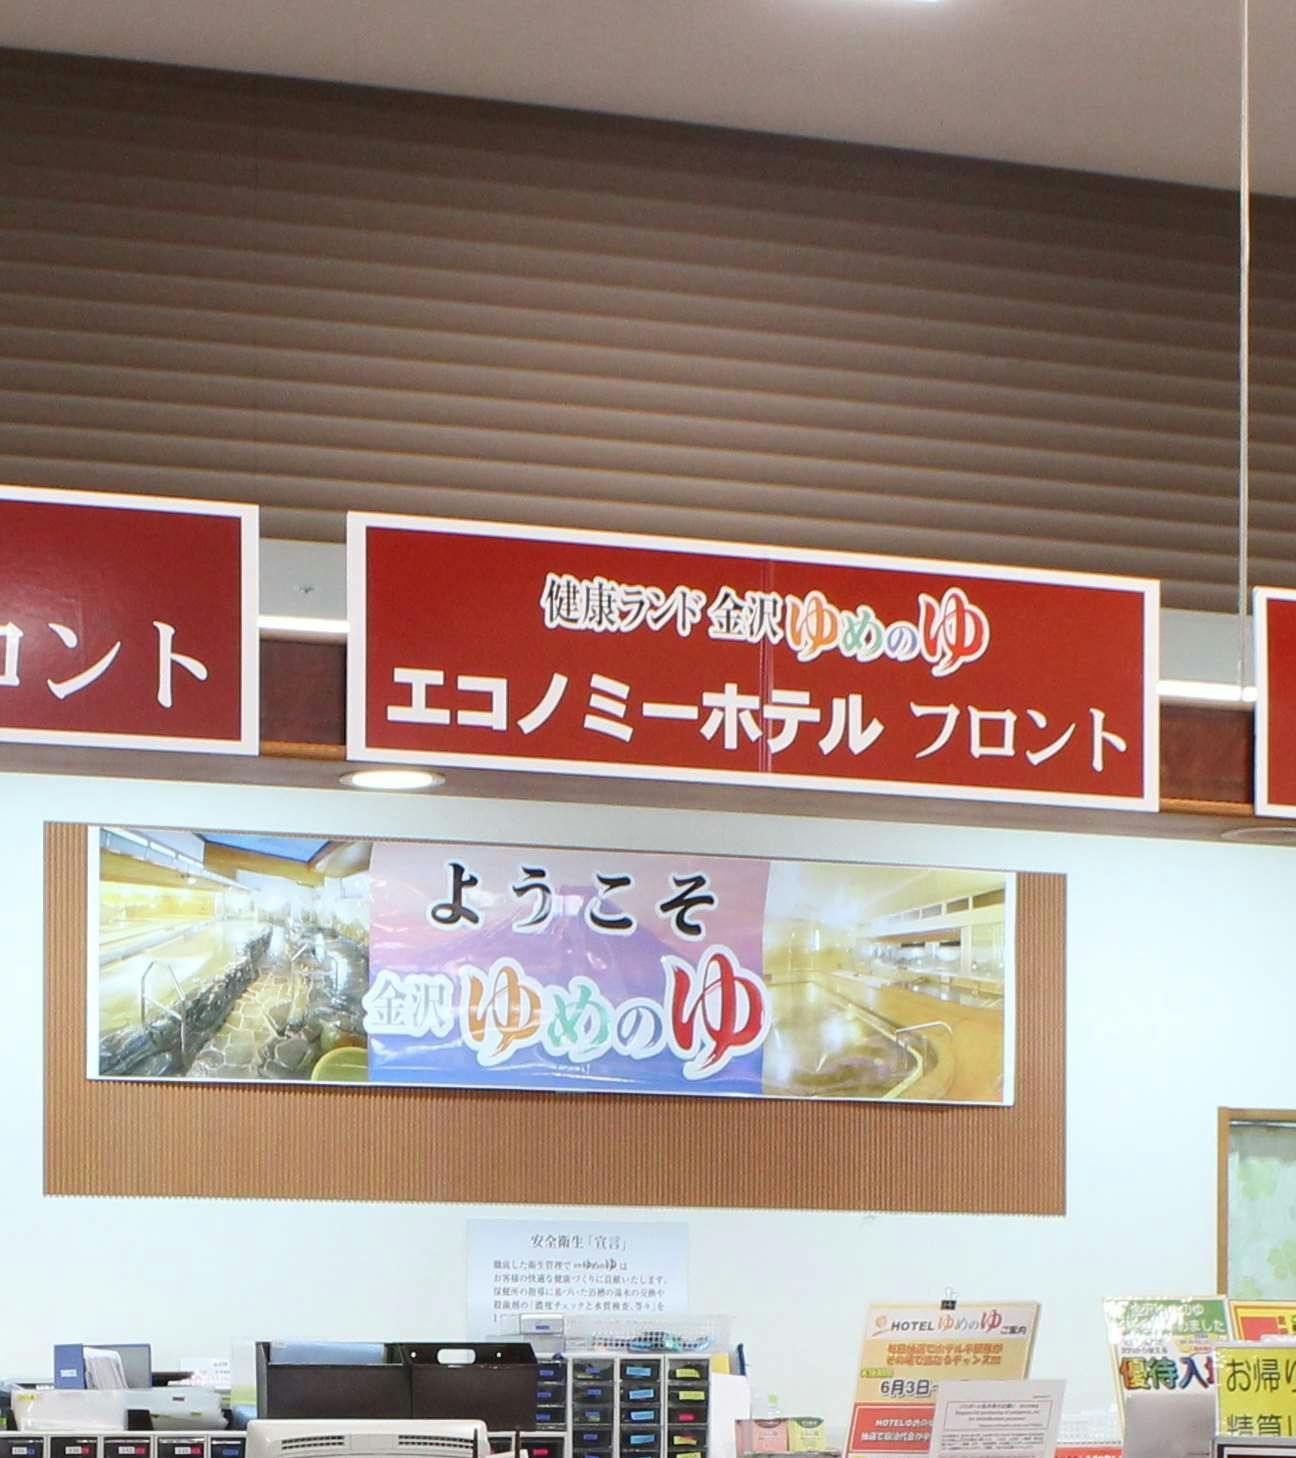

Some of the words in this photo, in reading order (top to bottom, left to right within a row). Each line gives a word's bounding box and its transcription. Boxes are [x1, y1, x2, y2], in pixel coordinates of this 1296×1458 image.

[541, 572, 706, 638] 健康ランド
[386, 666, 885, 758] エコノミーホテル
[909, 697, 1128, 773] フロント
[425, 860, 718, 940] ようこそ
[460, 946, 772, 1082] ゆめのゆ
[530, 1234, 628, 1252] 安全衛生「宣言」
[891, 1321, 935, 1332] HOTEL
